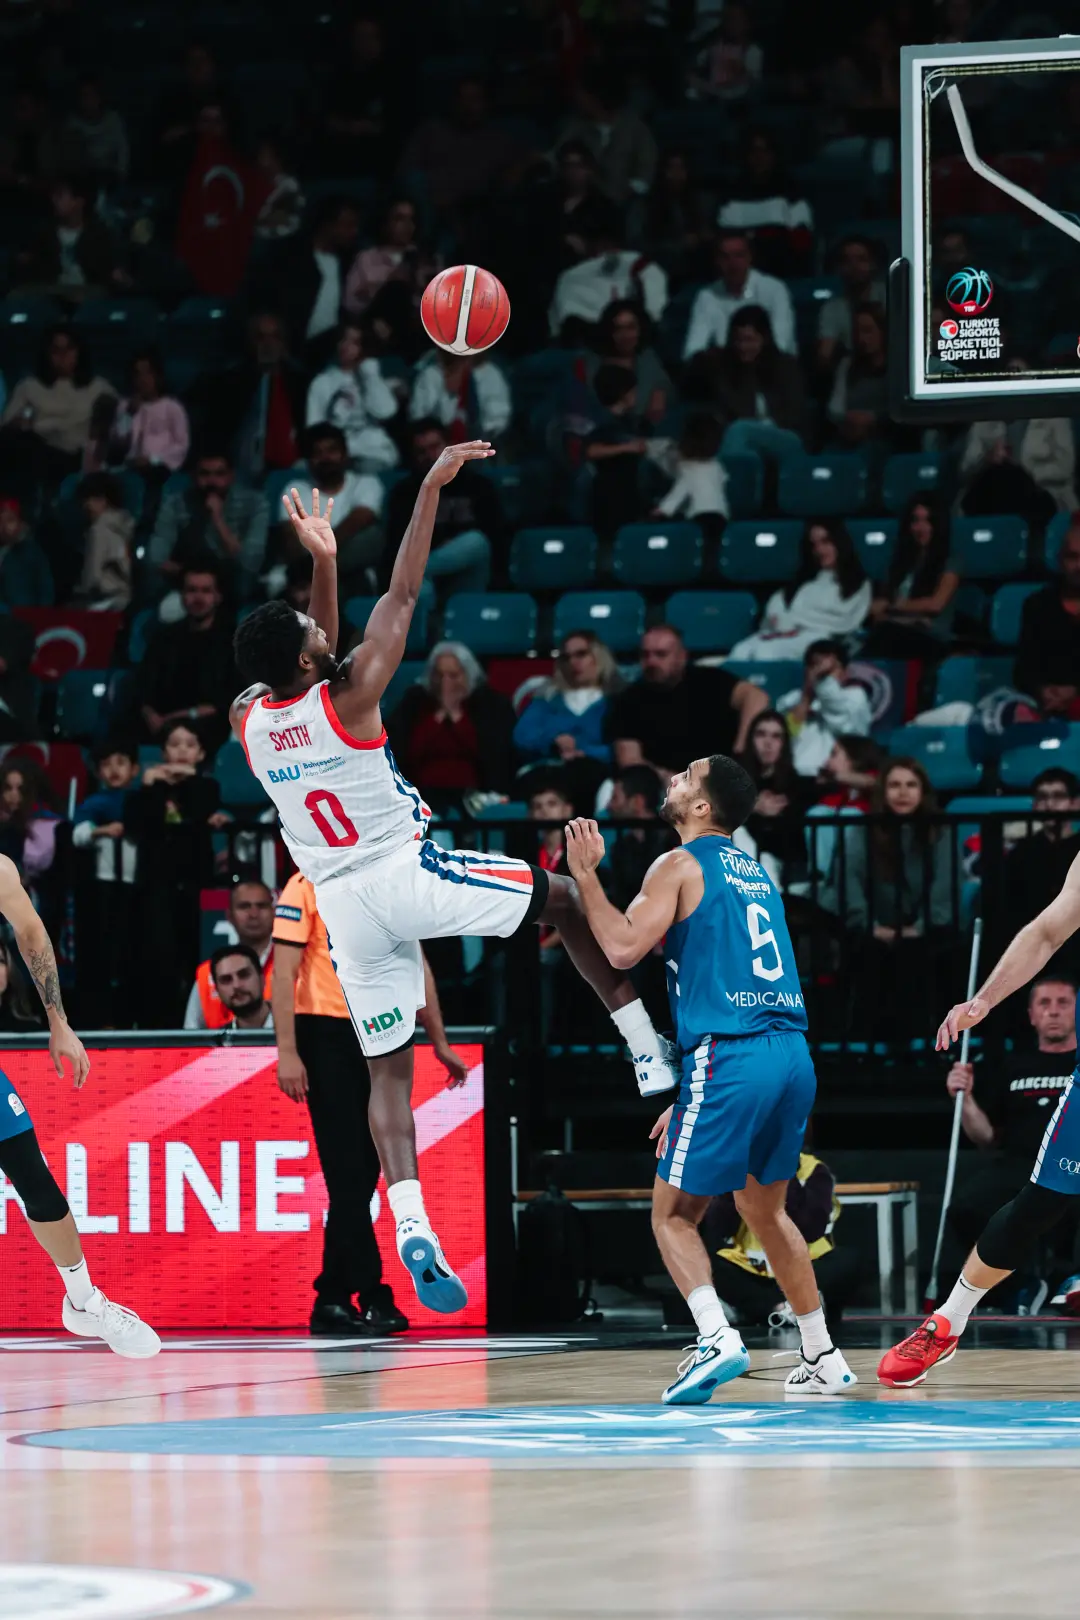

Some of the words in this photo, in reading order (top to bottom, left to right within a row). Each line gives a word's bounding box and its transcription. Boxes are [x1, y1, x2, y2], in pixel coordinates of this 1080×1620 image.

[938, 337, 1003, 349] BASKETBOL
[940, 350, 977, 361] SÜPER
[269, 725, 312, 752] SMITH
[267, 765, 301, 783] BAU
[304, 789, 359, 847] 0
[746, 902, 784, 982] 5
[726, 991, 804, 1008] MEDICANA
[362, 1006, 403, 1035] HDI
[368, 1023, 408, 1043] SIGORTA
[0, 1139, 381, 1234] LINE
